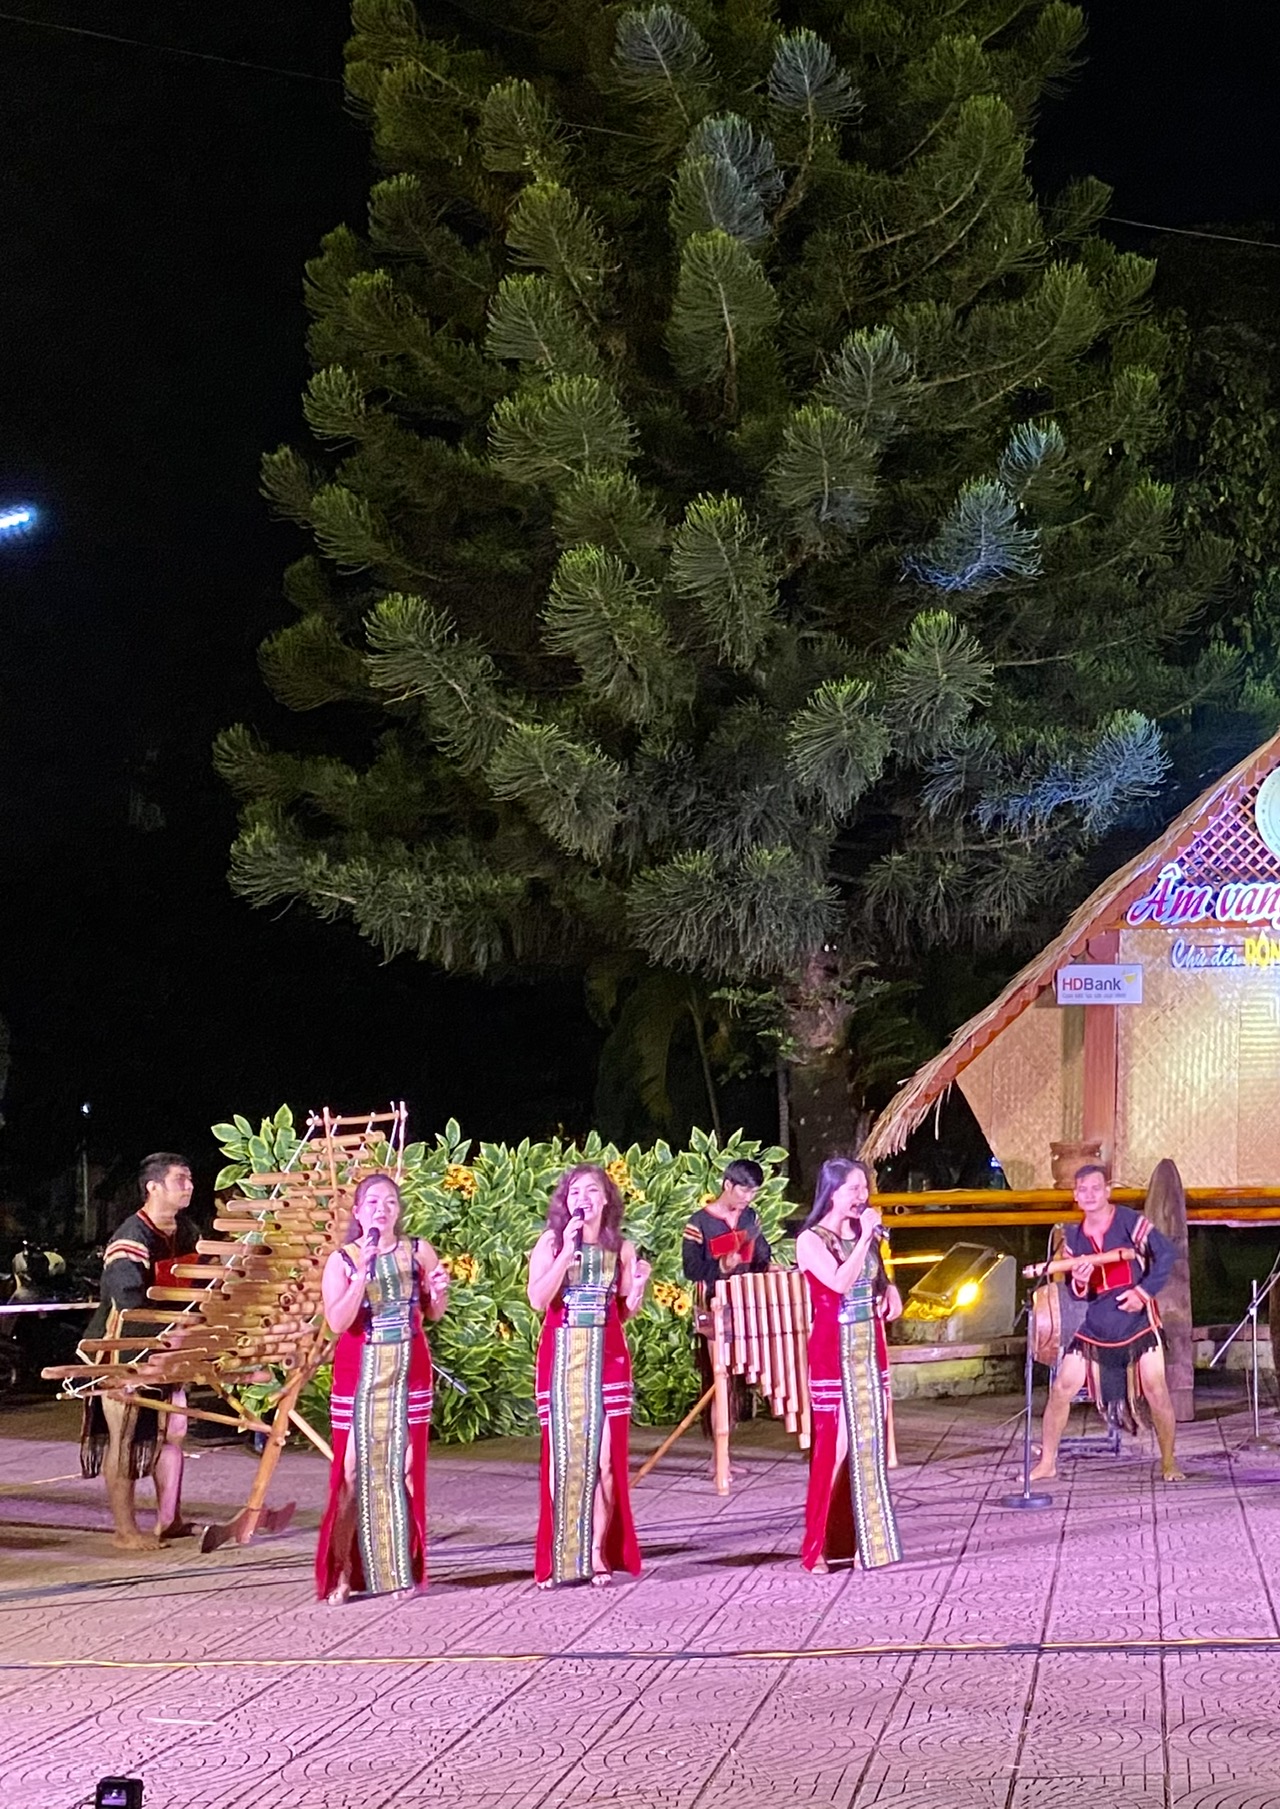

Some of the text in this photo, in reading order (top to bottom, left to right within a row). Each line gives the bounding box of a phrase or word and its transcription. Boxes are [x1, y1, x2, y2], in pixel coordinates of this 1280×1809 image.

[1128, 864, 1212, 924] Âm
[1172, 938, 1207, 969] Chủ
[1062, 977, 1122, 991] HDBank
